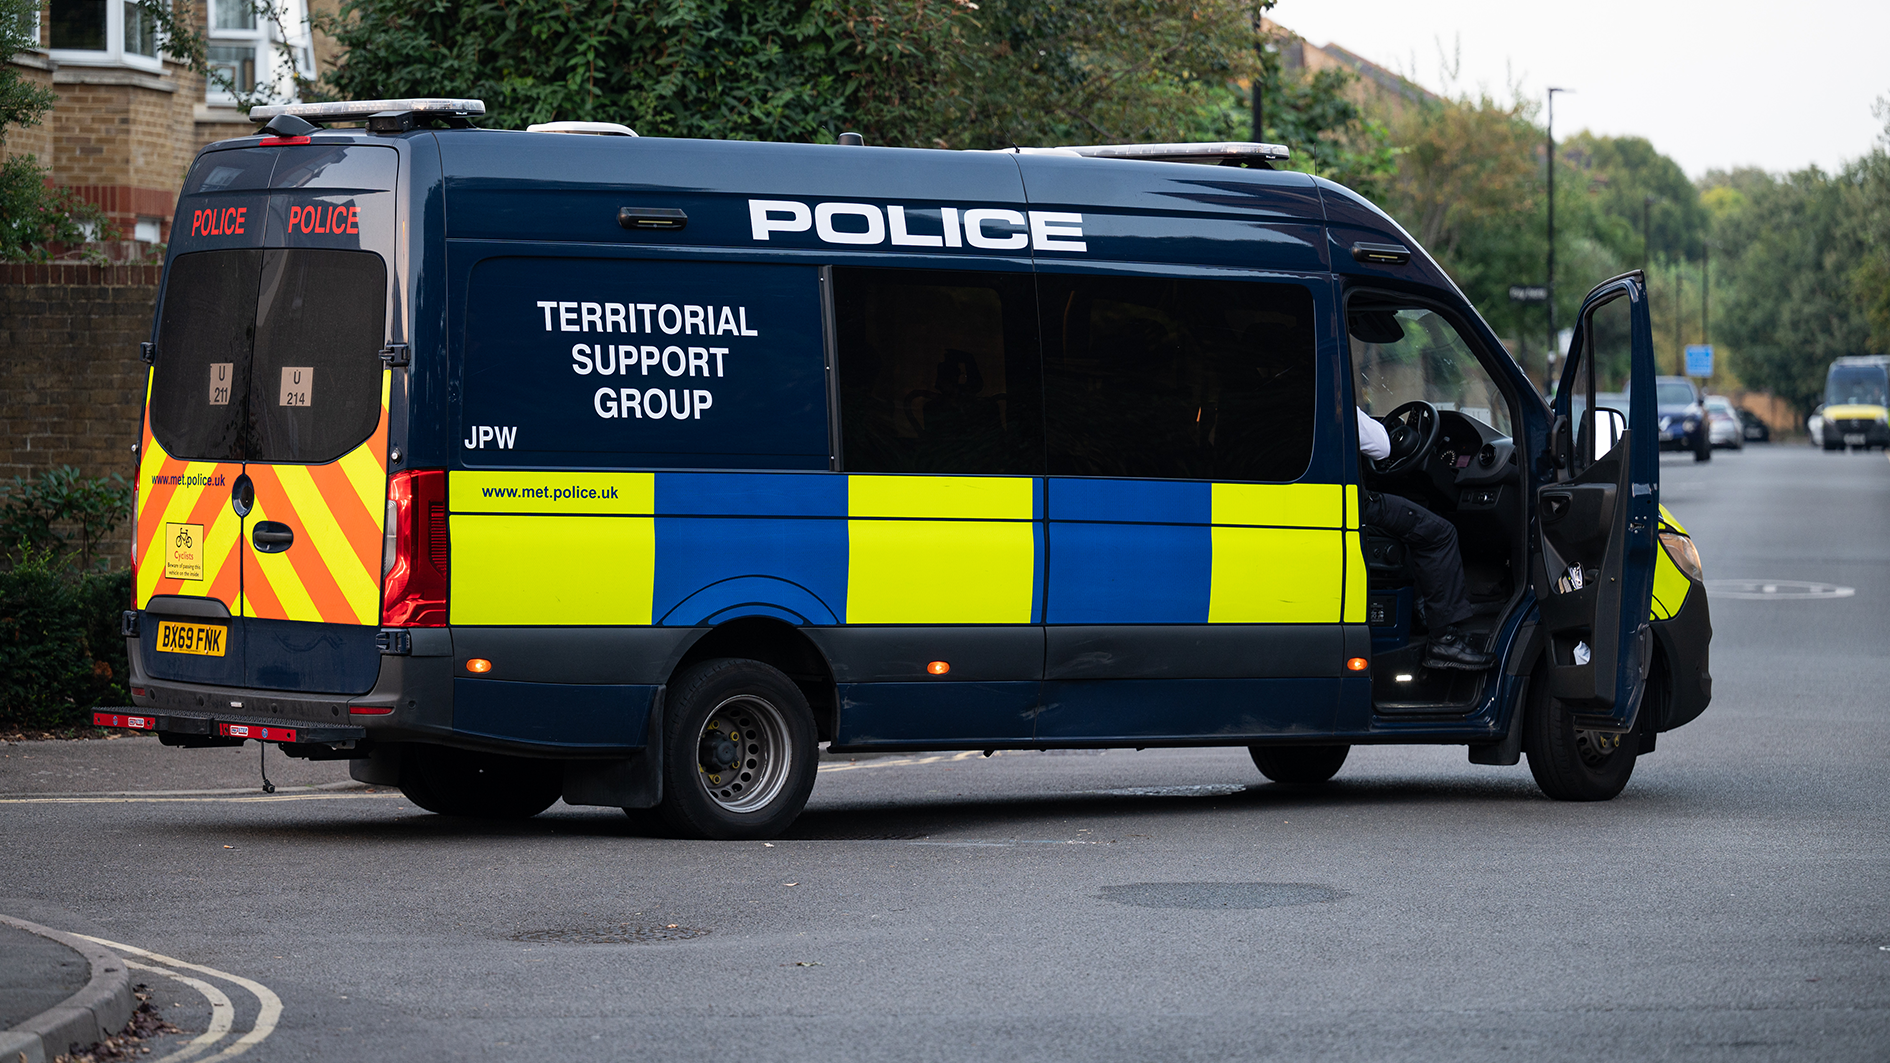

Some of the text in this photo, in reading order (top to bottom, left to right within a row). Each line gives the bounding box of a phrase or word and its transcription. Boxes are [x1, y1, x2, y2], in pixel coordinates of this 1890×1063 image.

[191, 207, 247, 237] POLICE
[288, 205, 361, 235] POLICE
[748, 199, 1087, 252] POLICE
[537, 300, 758, 337] TERRITORIAL
[571, 343, 729, 377] SUPPORT
[218, 365, 226, 382] U
[293, 371, 301, 385] U
[214, 387, 228, 403] 211
[287, 392, 306, 405] 214
[594, 387, 713, 420] GROUP
[464, 425, 517, 449] JPW
[151, 473, 226, 488] www.met.police.uk
[482, 486, 619, 501] www.met.police.uk
[174, 550, 194, 561] Cyclists
[162, 625, 222, 652] BX69 FNK
